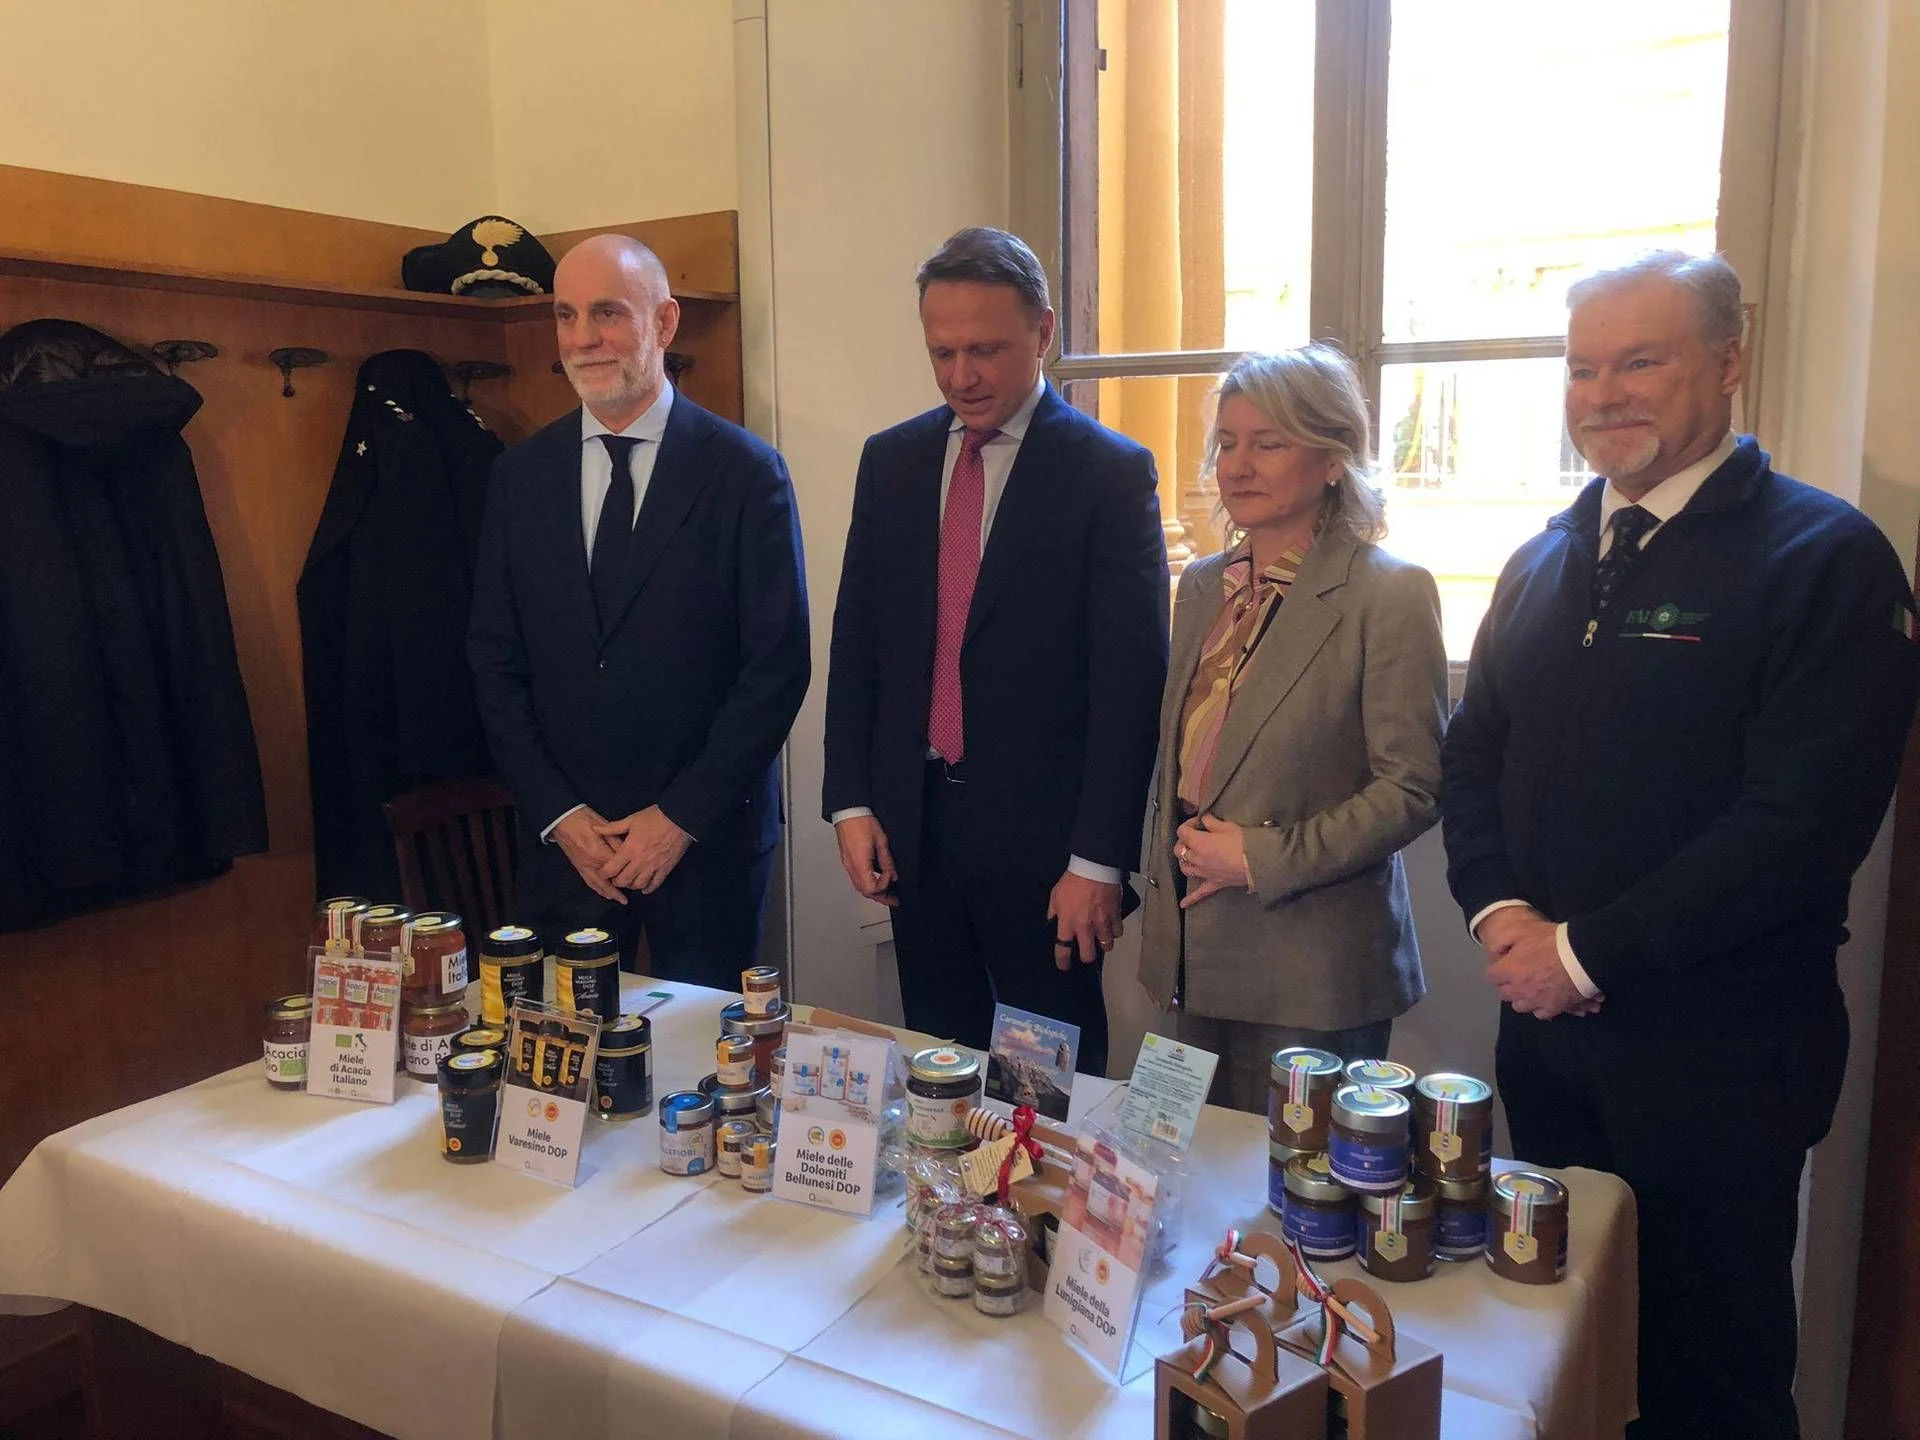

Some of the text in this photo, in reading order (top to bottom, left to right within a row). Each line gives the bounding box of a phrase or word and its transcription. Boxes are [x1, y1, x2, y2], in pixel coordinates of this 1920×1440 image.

[420, 1039, 432, 1051] di
[339, 1054, 364, 1064] Miele
[330, 1063, 371, 1076] di Acacia
[333, 1074, 367, 1086] Italiano
[527, 1128, 551, 1142] Miele
[509, 1135, 568, 1158] Varesino DOP
[796, 1149, 853, 1168] Miele delle
[801, 1162, 847, 1180] Dolomiti
[785, 1171, 834, 1190] Bellunesi
[836, 1181, 861, 1195] DOP
[1066, 1275, 1110, 1318] Miele della
[1056, 1282, 1116, 1336] Lunigiana DOP
